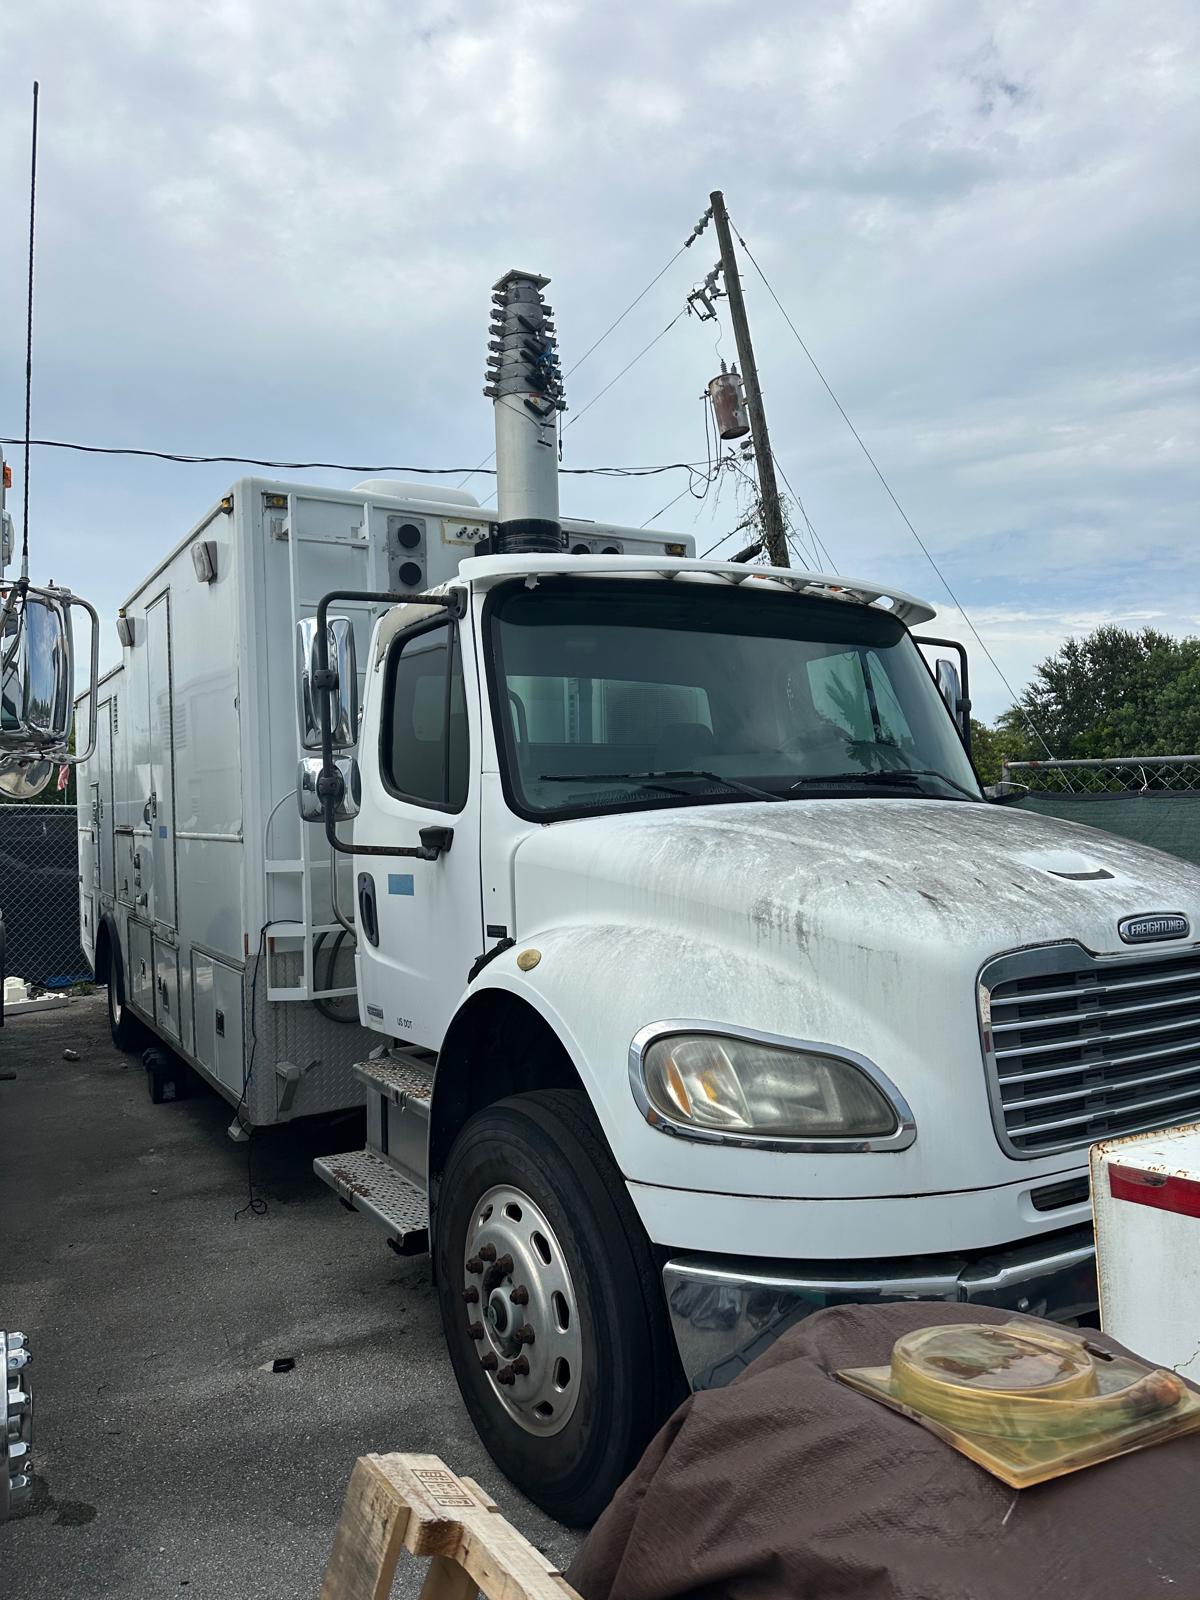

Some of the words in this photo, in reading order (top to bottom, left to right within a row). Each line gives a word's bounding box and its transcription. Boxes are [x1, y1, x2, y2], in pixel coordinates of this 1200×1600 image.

[1131, 919, 1186, 935] FREIGHTLINER
[397, 1017, 404, 1027] US
[403, 1018, 413, 1030] DOT
